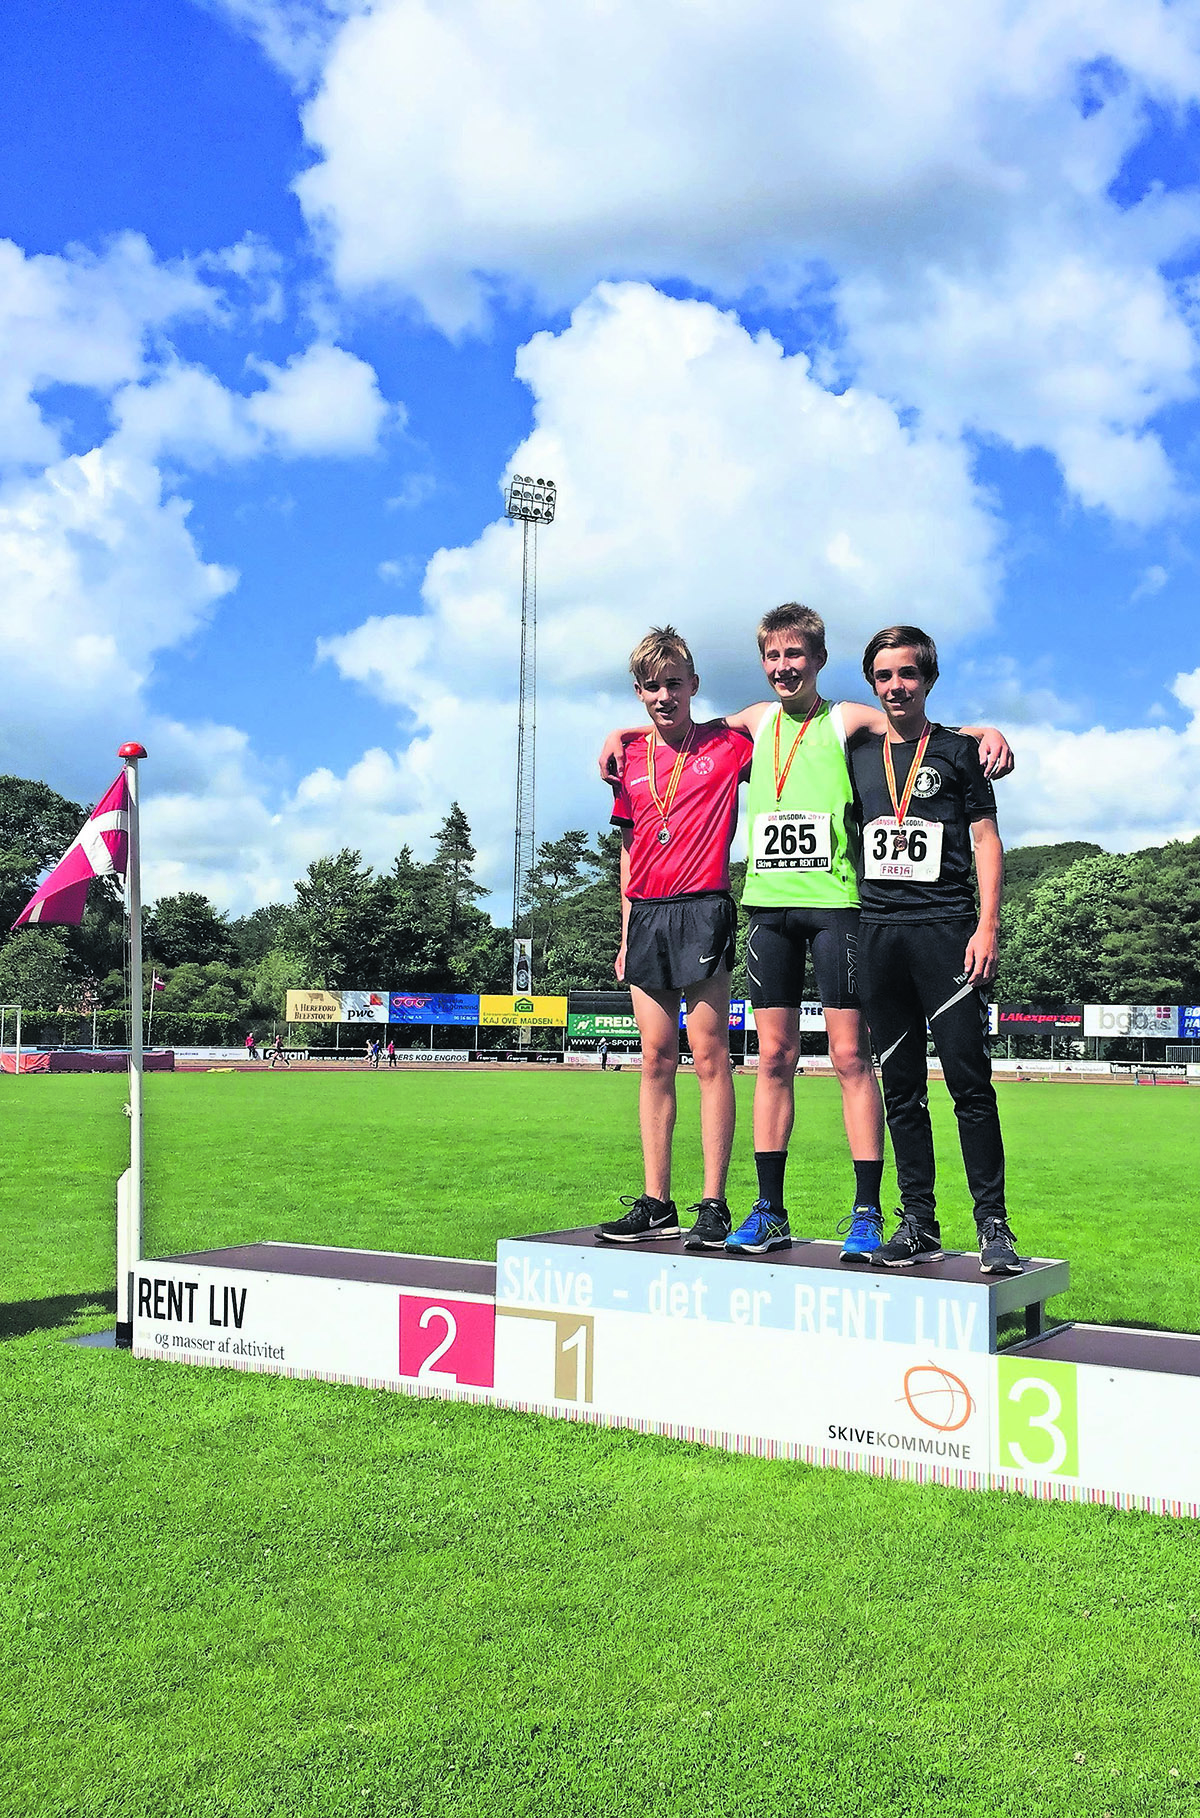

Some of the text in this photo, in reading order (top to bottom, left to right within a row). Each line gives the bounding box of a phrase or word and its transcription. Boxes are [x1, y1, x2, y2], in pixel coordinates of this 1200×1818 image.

[764, 824, 817, 855] 265
[872, 828, 928, 862] 376
[817, 858, 827, 866] LIV
[881, 865, 911, 875] FREJA
[347, 1008, 375, 1020] pwc
[483, 1016, 499, 1024] KAJ
[520, 1017, 553, 1025] MADSEN
[434, 1054, 467, 1062] ENGROS
[138, 1277, 248, 1329] RENT LIV
[502, 1255, 977, 1352] Skive - det er RENT LIV
[155, 1333, 285, 1361] og masser af aktivitet
[418, 1306, 458, 1382] 2
[561, 1324, 587, 1402] 1
[1007, 1377, 1068, 1474] 3
[828, 1424, 971, 1460] SKIVEKOMMUNE
